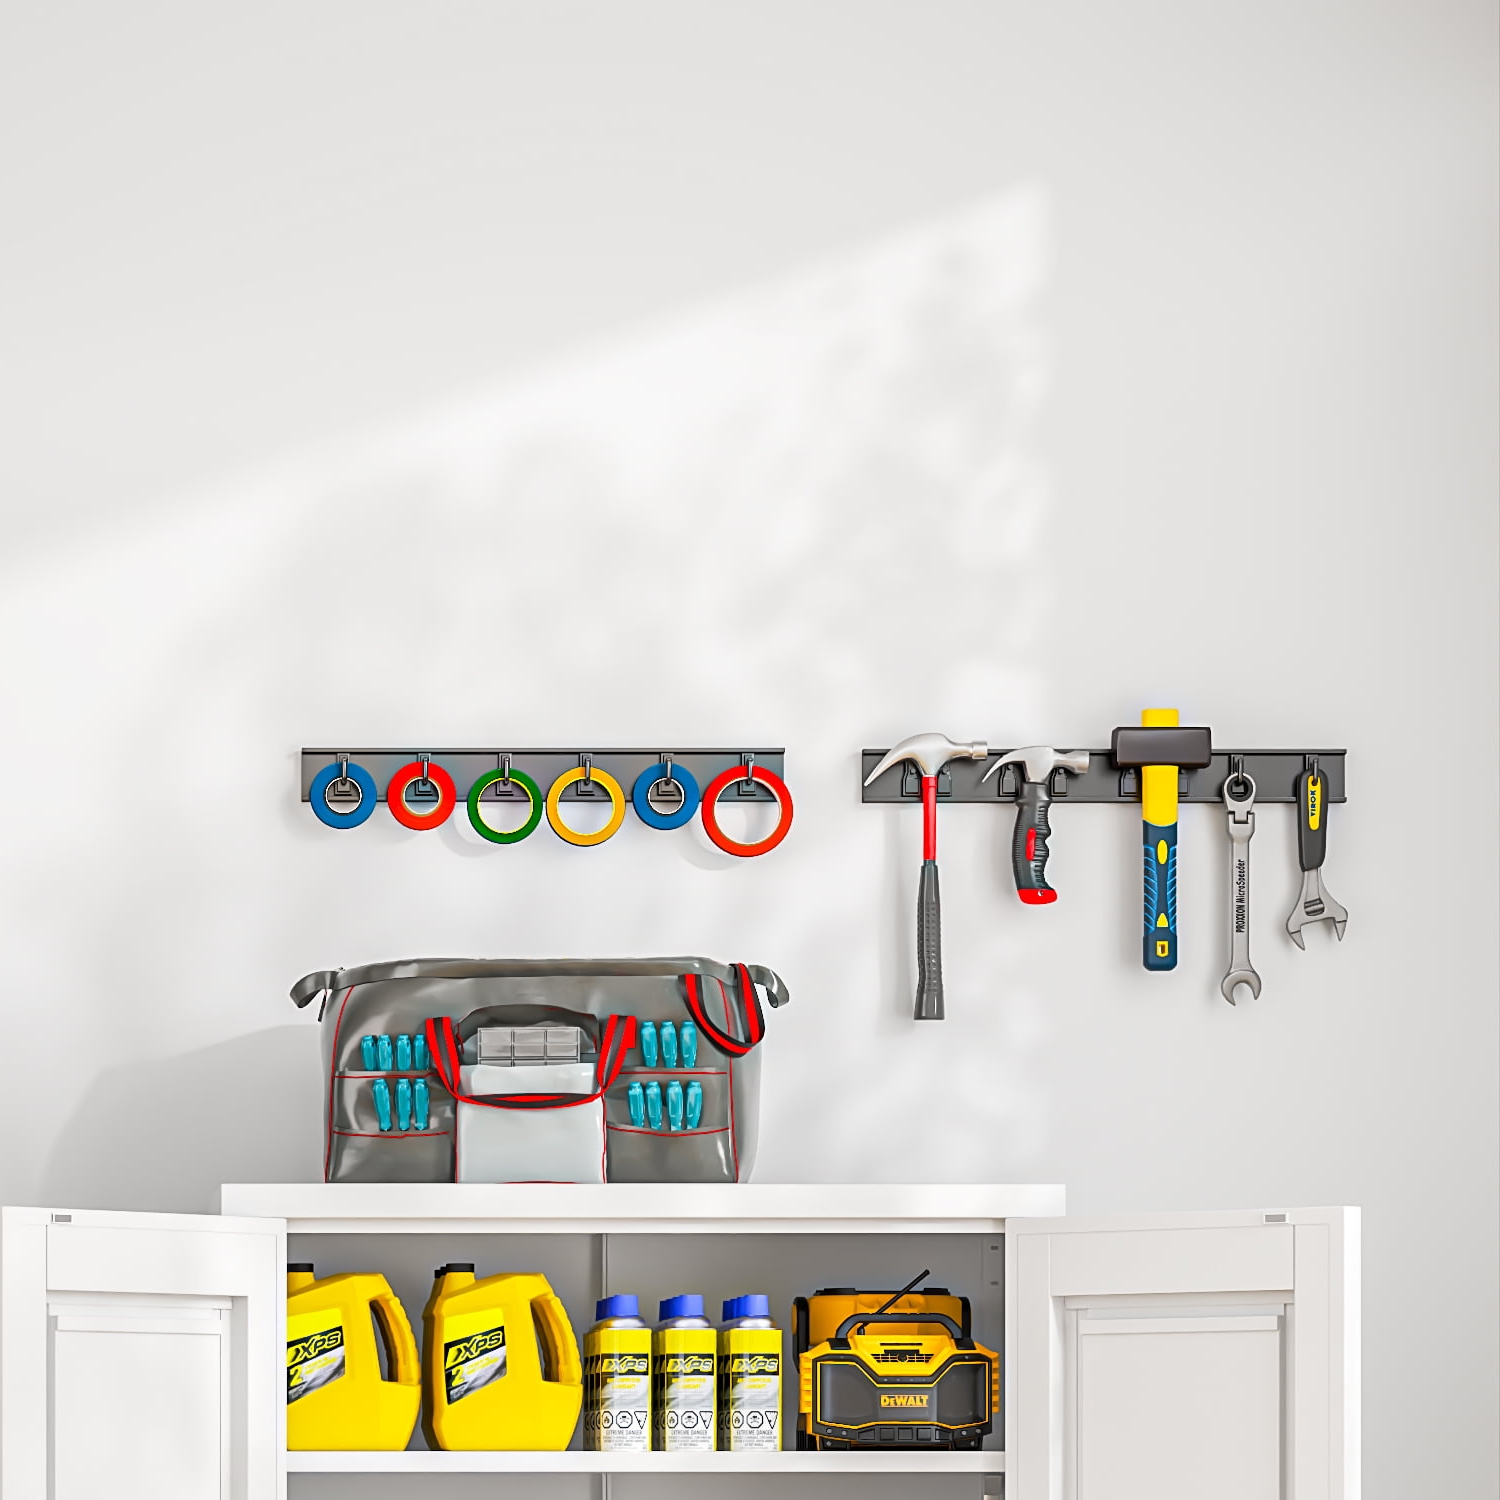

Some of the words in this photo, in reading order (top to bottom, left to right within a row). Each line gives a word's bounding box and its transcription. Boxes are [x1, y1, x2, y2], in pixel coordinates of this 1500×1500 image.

[1235, 859, 1246, 904] MicroSpeeder
[1235, 904, 1246, 933] PROXXON
[294, 1331, 341, 1361] XPS
[454, 1331, 502, 1363] XPS
[605, 1356, 647, 1373] XPS
[669, 1356, 713, 1373] XPS
[734, 1356, 778, 1373] XPS
[290, 1365, 303, 1387] 2
[452, 1365, 465, 1387] 2
